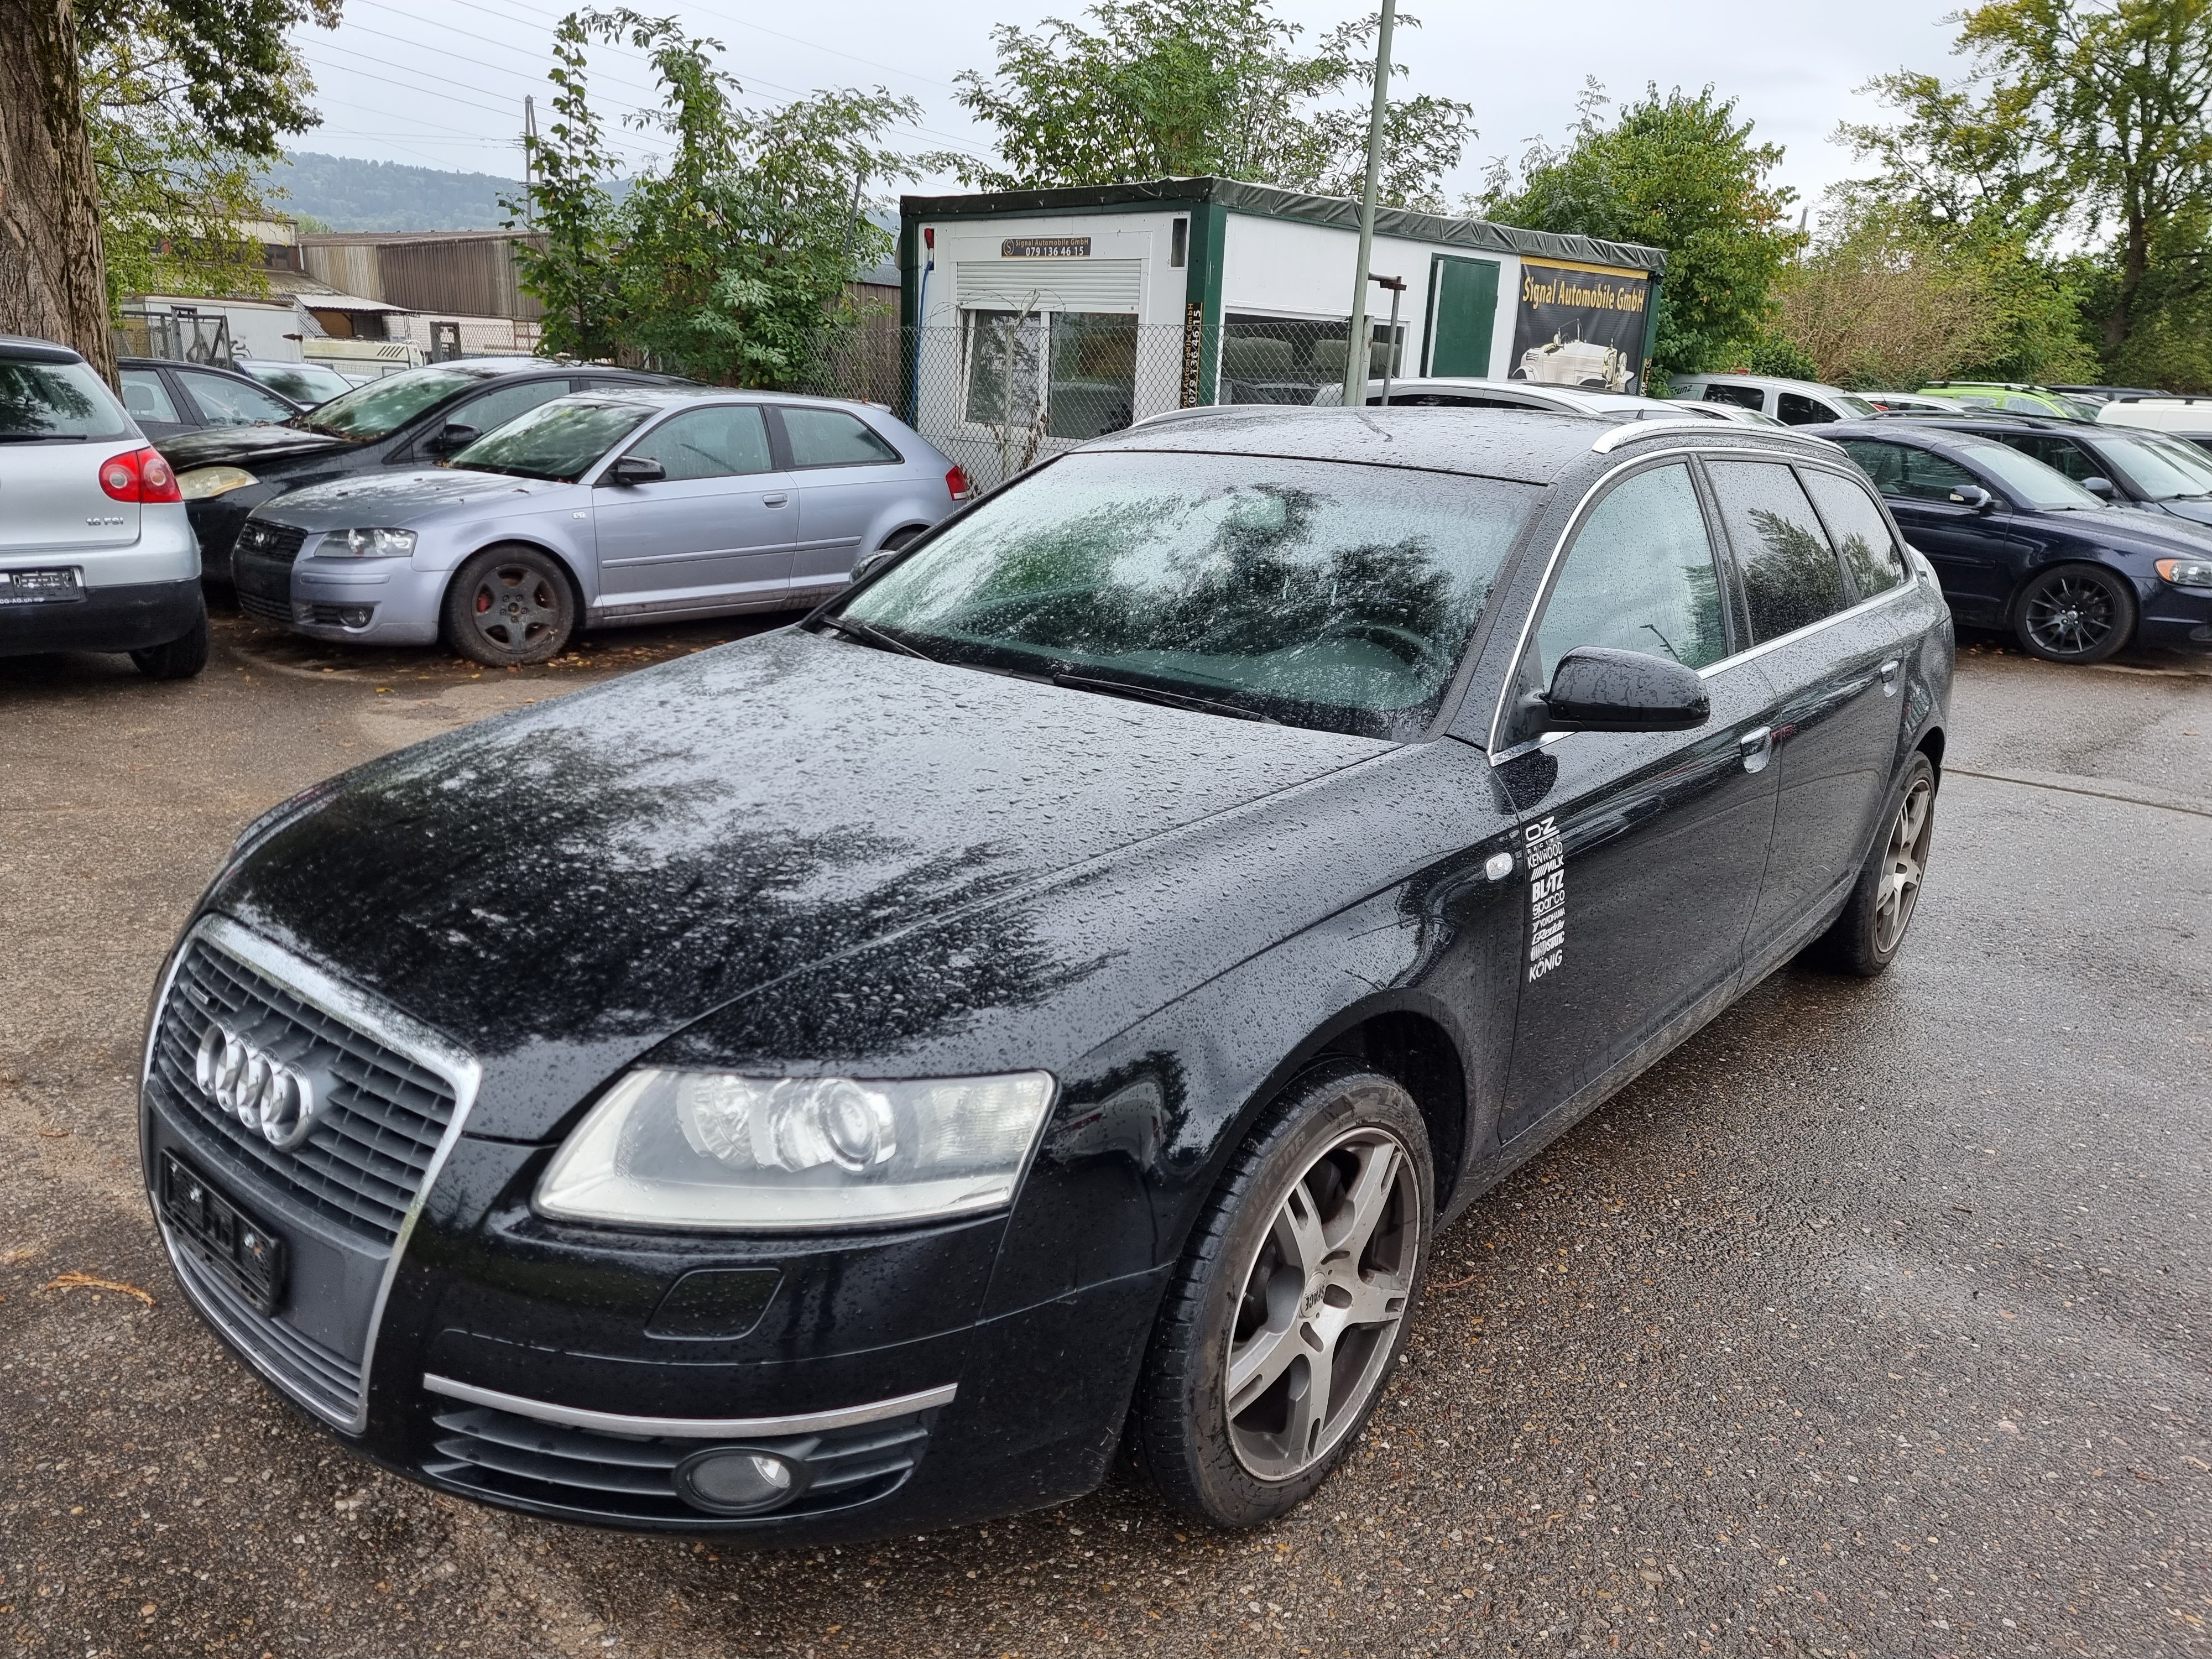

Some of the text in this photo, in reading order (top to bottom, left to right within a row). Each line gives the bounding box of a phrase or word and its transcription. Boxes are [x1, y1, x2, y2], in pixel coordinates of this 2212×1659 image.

[1015, 239, 1034, 248] Signal
[1035, 238, 1069, 247] Automobile
[1025, 246, 1084, 257] 079 136 46 15
[1522, 276, 1645, 312] Signal Automobile GmbH
[1193, 310, 1201, 326] 15
[1192, 330, 1199, 347] 46
[103, 517, 123, 526] FSI
[1527, 834, 1560, 854] RACING
[1527, 841, 1563, 869] KENWOOD
[1532, 869, 1564, 903] BLITZ
[1532, 889, 1565, 919] sparco
[1538, 907, 1566, 928] YOKOHAMA
[1529, 949, 1563, 983] KÖNIG
[1305, 1285, 1325, 1311] SPACE
